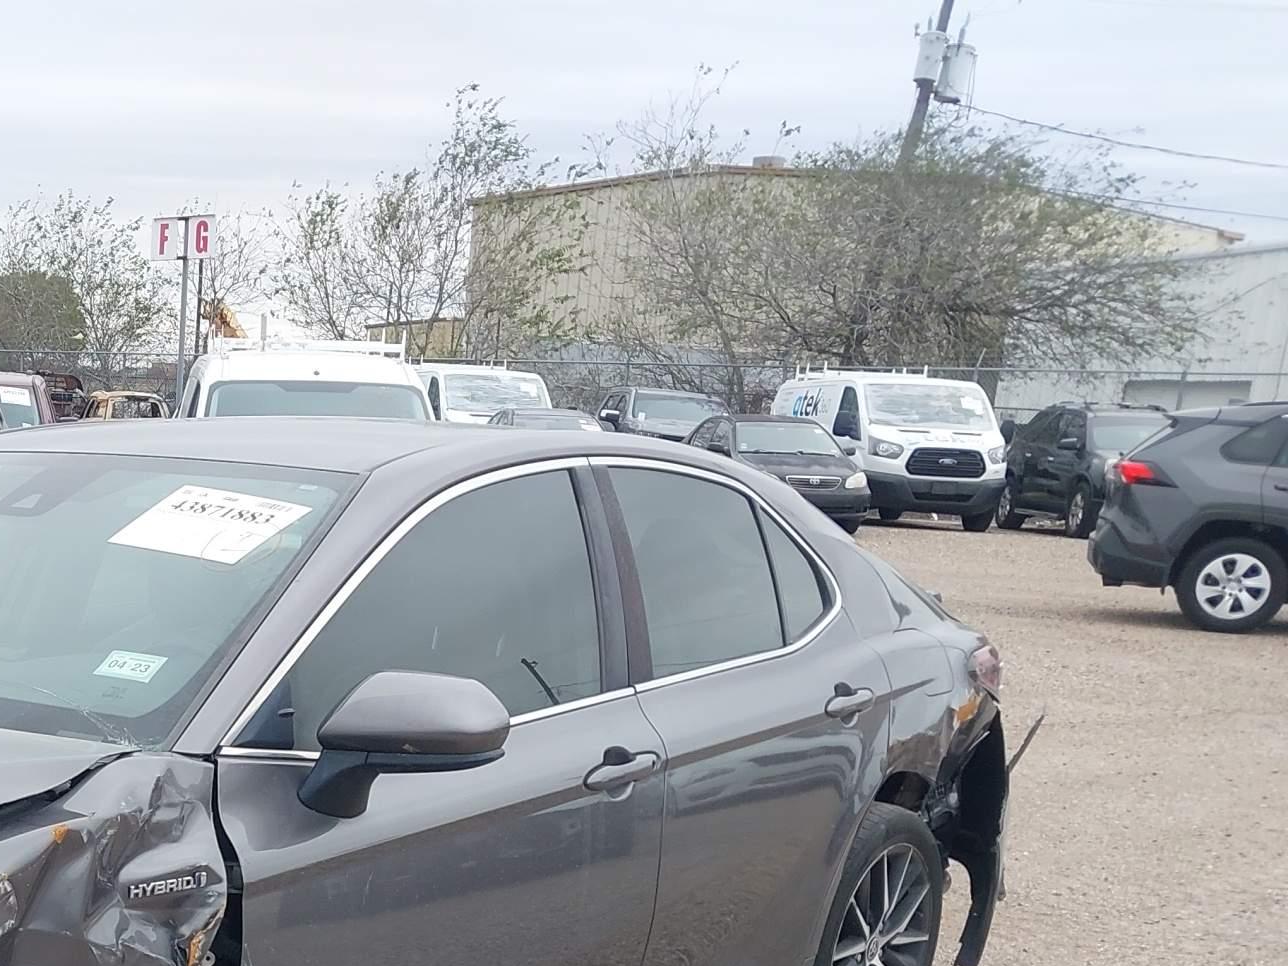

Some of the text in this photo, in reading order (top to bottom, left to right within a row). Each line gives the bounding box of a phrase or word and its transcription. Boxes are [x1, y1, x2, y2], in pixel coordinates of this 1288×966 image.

[159, 223, 169, 255] F
[196, 220, 208, 253] G
[170, 500, 275, 525] 43871883
[107, 659, 151, 673] 04 23
[129, 876, 196, 899] HYBRID
